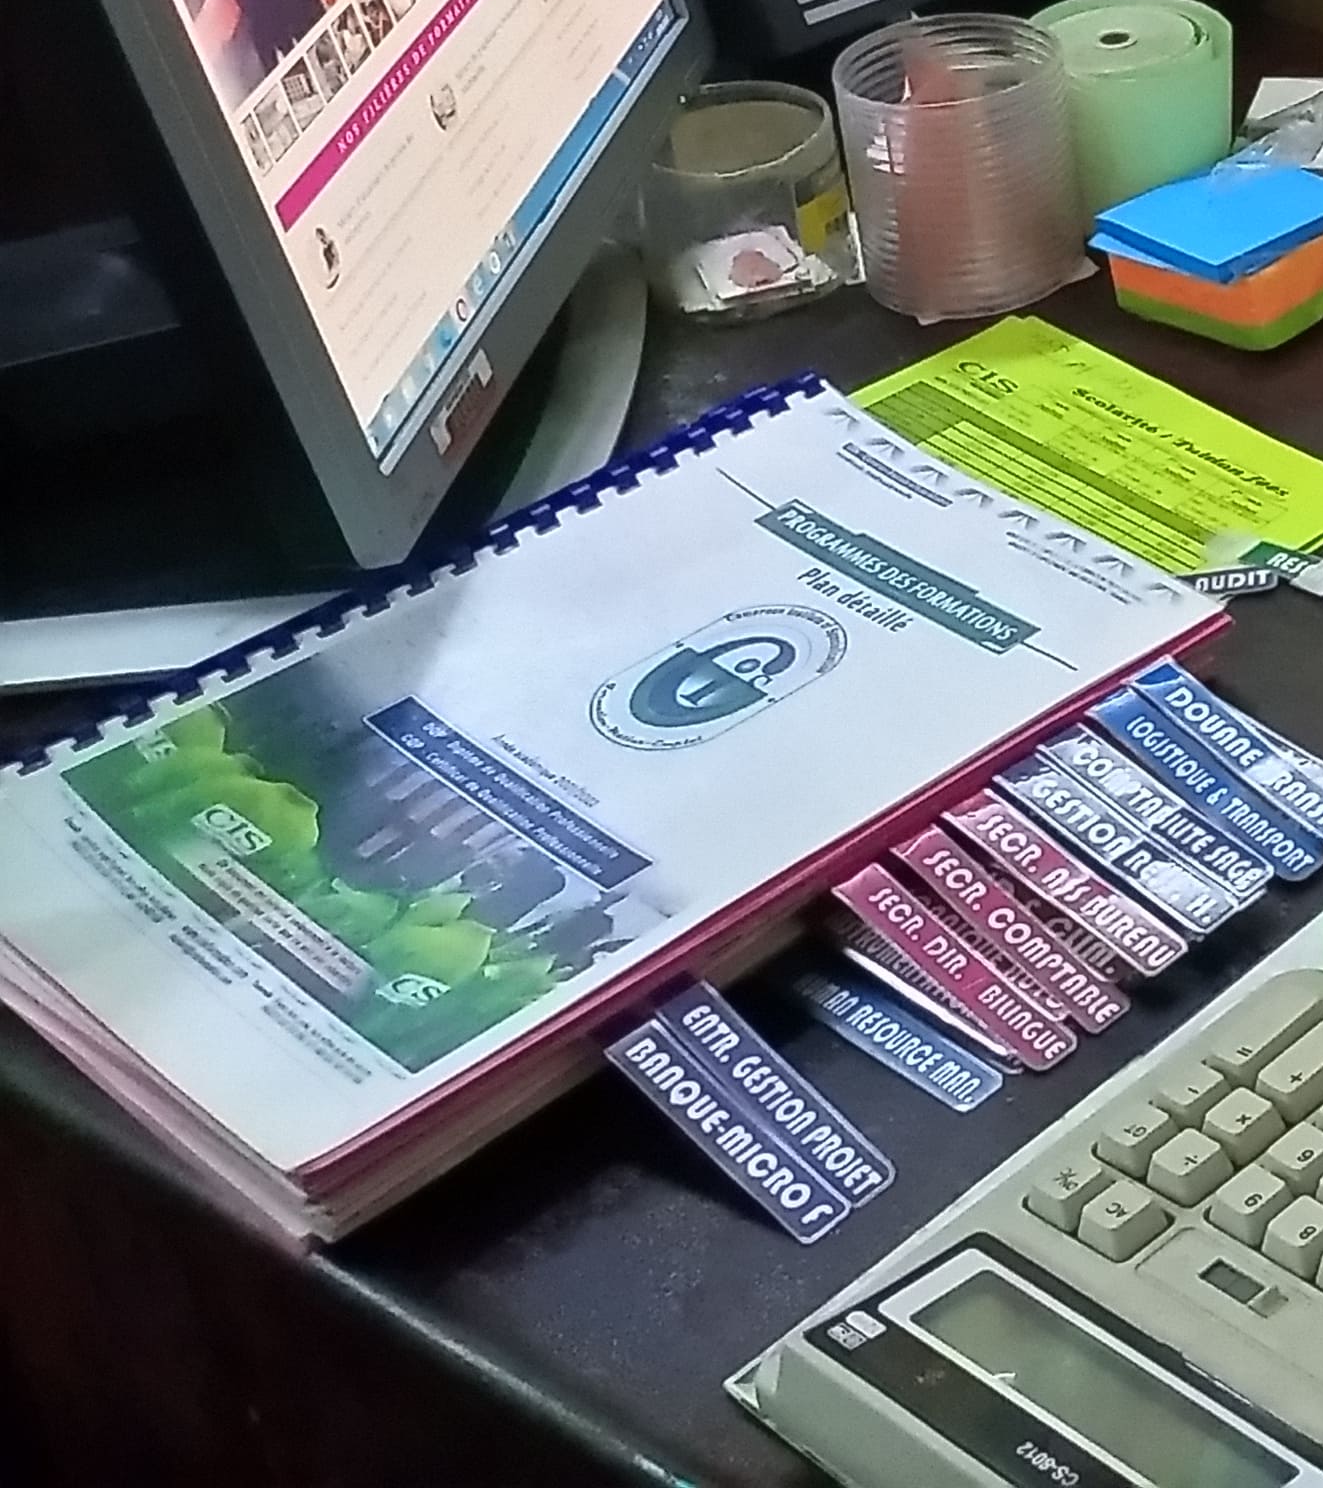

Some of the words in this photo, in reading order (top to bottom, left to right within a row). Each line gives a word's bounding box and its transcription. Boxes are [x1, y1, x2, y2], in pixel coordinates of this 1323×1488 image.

[334, 118, 362, 156] NOS
[409, 40, 428, 67] DE
[955, 360, 1020, 396] CIS
[1071, 386, 1159, 435] Scolarité
[1241, 471, 1290, 499] fees
[776, 508, 888, 574] PROGRAMMES
[878, 566, 915, 591] DES
[907, 577, 1019, 642] FORMATIONS
[797, 566, 838, 599] Plan
[838, 592, 916, 634] détaillé
[1195, 569, 1272, 593] AUDIT
[1164, 686, 1265, 769] DOUANE
[206, 808, 264, 851] CIS
[1030, 776, 1131, 866] GESTION
[1072, 747, 1216, 853] COMPTABILITE
[1203, 845, 1262, 899] SAGE
[1125, 715, 1216, 796] LOGISTIQUE
[1206, 786, 1229, 806] &
[1219, 795, 1317, 873] TRANSPORT
[922, 850, 988, 911] SECR.
[987, 907, 1121, 1024] COMPTABLE
[975, 815, 1043, 874] SECR.
[1041, 867, 1092, 903] ASS
[1080, 895, 1177, 968] BUREAU
[868, 886, 928, 942] SECR.
[922, 935, 972, 981] DIR.
[977, 984, 1067, 1060] BILINGUE
[682, 1005, 741, 1063] ENTR.
[731, 1055, 817, 1135] GESTION
[801, 1125, 884, 1195] PROJET
[846, 994, 944, 1072] RESOURCE
[927, 1060, 983, 1104] MAN.
[624, 1036, 811, 1209] BANQUE-MICRO
[1105, 1201, 1128, 1219] AC
